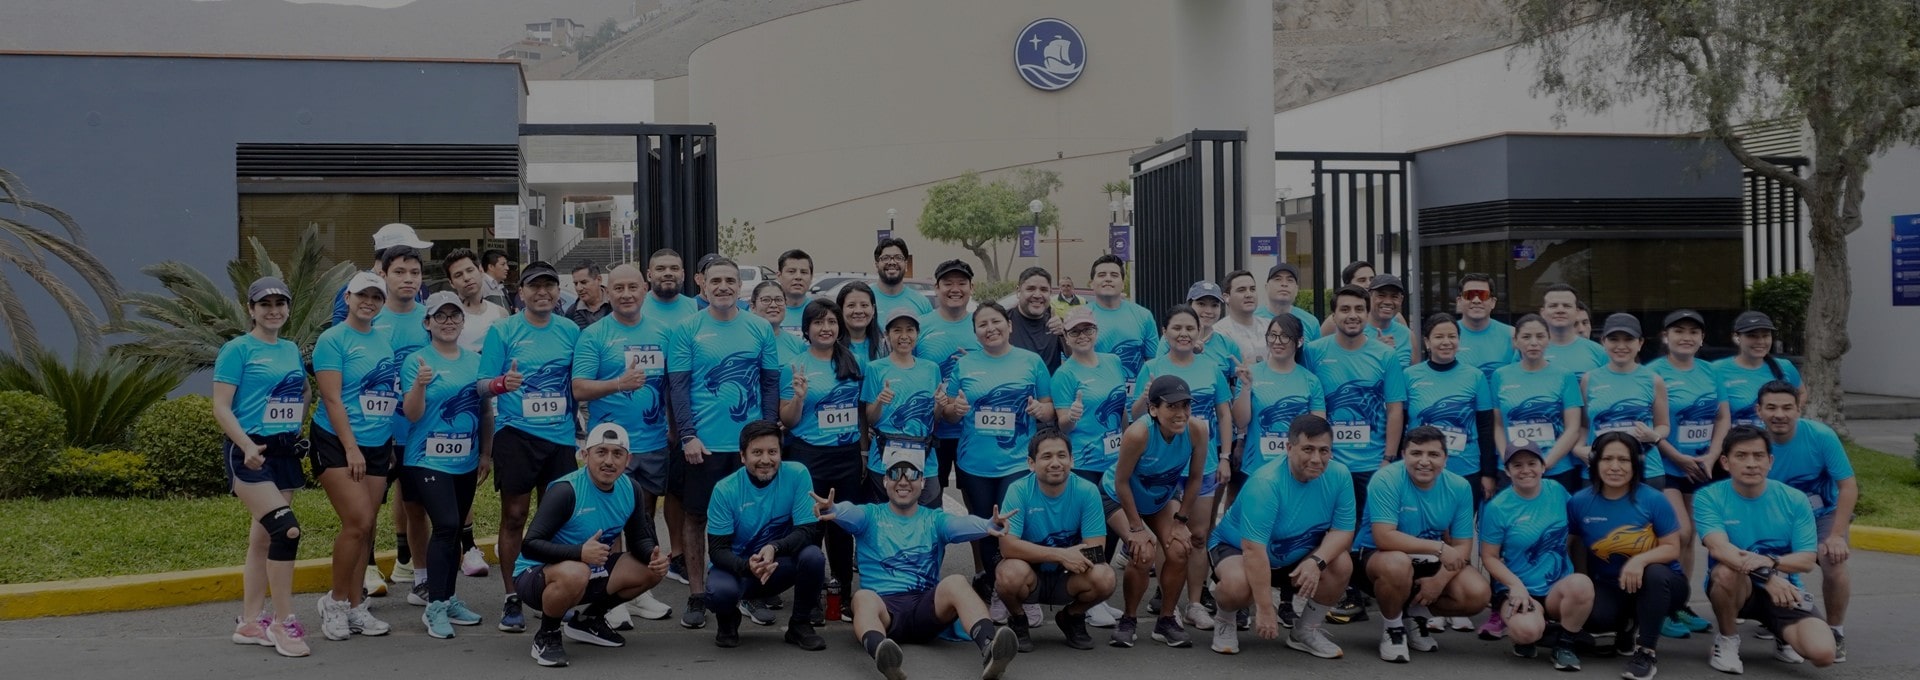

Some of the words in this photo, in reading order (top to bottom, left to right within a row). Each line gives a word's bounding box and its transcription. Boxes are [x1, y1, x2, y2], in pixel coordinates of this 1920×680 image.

[367, 400, 389, 411] 017
[532, 401, 558, 412] 019
[270, 408, 294, 419] 018
[827, 412, 849, 424] 011
[982, 415, 1006, 425] 023
[1336, 430, 1361, 440] 026
[1517, 427, 1543, 438] 021
[435, 443, 463, 453] 030
[1110, 437, 1121, 448] 02
[1268, 441, 1285, 450] 04
